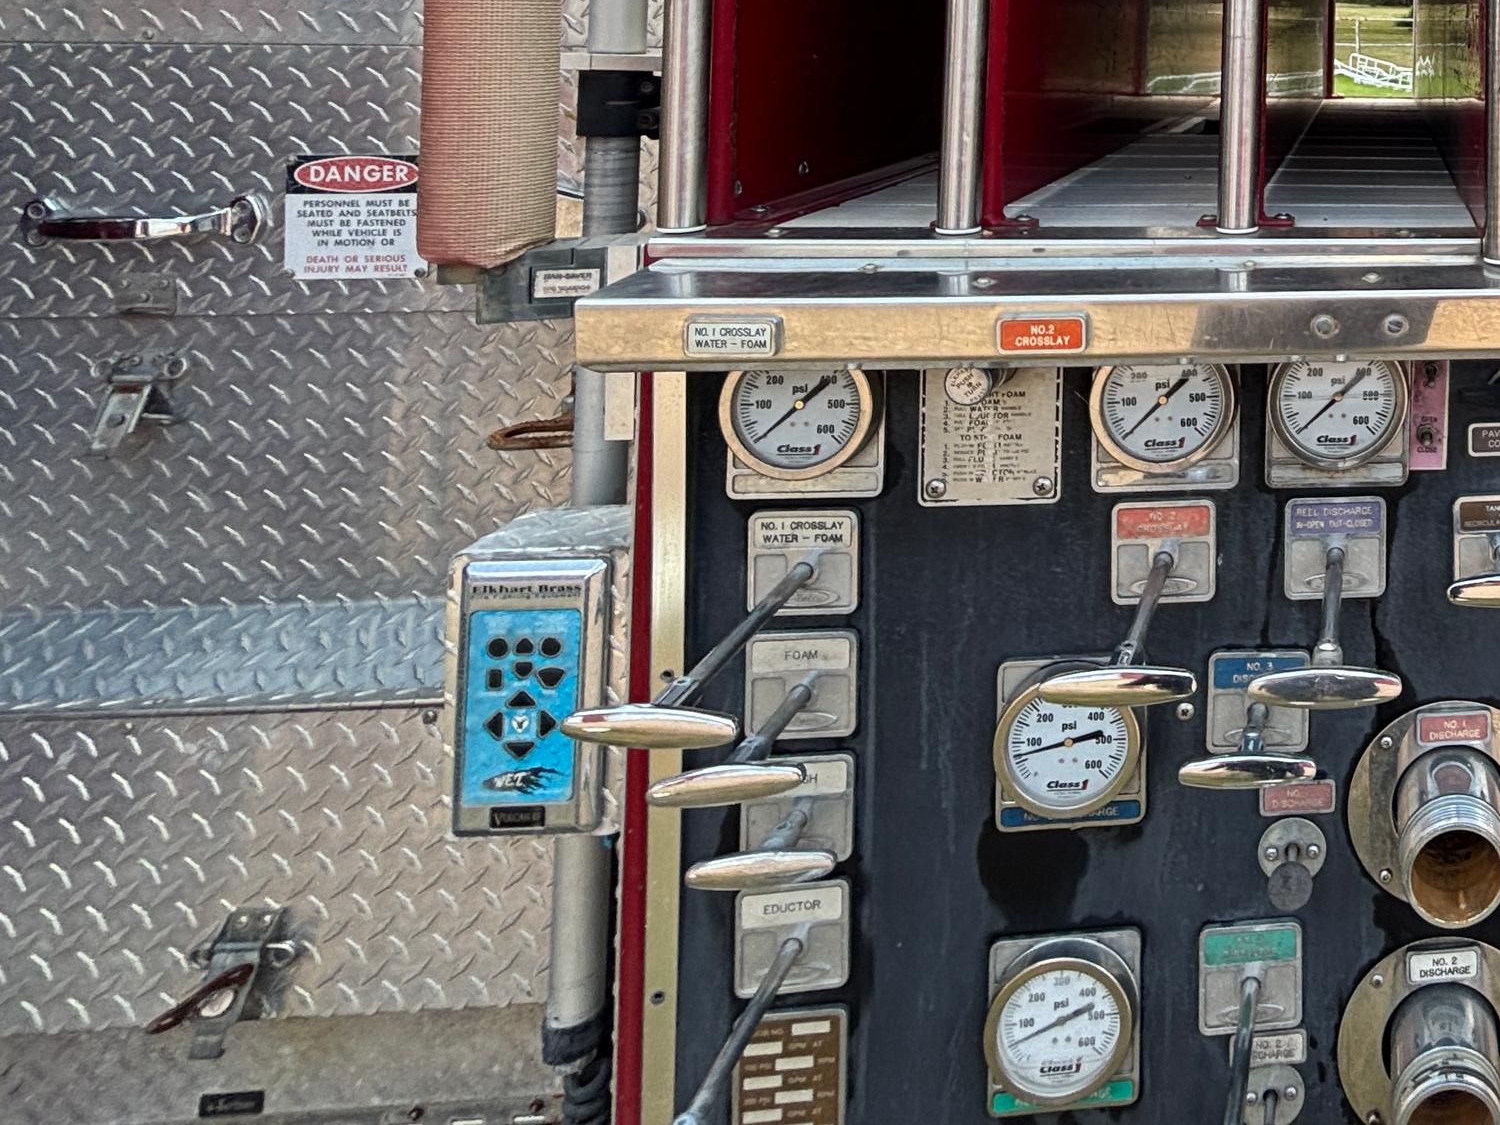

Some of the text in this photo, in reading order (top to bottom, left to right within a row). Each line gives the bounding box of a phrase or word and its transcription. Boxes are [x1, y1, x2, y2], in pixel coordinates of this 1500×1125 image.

[309, 165, 408, 182] DANGER
[297, 210, 333, 218] SEATED
[367, 209, 417, 217] SEATBELTS
[307, 219, 334, 227] MUST
[339, 219, 351, 227] BE
[312, 229, 342, 237] WHILE
[381, 238, 395, 246] OR
[306, 255, 338, 263] DEATH
[364, 254, 406, 262] SERIOUS
[374, 264, 408, 272] RESULT
[695, 328, 710, 337] NO.
[720, 328, 767, 337] CROSSLAY
[1031, 325, 1055, 335] NO.2
[695, 340, 768, 348] WATER FOAM
[1016, 336, 1070, 346] CROSSLAY
[766, 375, 784, 385] 200
[1155, 378, 1171, 391] psi
[792, 384, 808, 395] psi
[964, 382, 983, 397] TURN
[1121, 397, 1137, 406] 100
[1189, 393, 1206, 402] 500
[755, 399, 772, 409] 100
[828, 399, 845, 409] 500
[1180, 418, 1198, 427] 600
[1353, 415, 1369, 425] 600
[817, 424, 835, 434] 600
[1296, 506, 1373, 516] REEL DISCHARGE
[761, 522, 778, 531] NO.
[790, 521, 844, 530] CROSSLAY
[762, 533, 843, 543] WATER FOAM
[472, 584, 582, 596] Elkhart Brass
[785, 650, 818, 660] FOAM
[1036, 713, 1054, 723] 200
[1088, 711, 1105, 721] 400
[1062, 721, 1077, 732] psi
[1429, 729, 1480, 740] DISCHARGE
[1026, 738, 1042, 747] 100
[1085, 760, 1103, 769] 600
[763, 899, 822, 915] EDUCTOR
[1432, 956, 1458, 966] NO. 2
[1420, 966, 1471, 978] DISCHARGE
[1028, 993, 1045, 1002] 200
[1054, 998, 1069, 1010] psi
[1020, 1018, 1035, 1028] 100
[1078, 1037, 1096, 1047] 600
